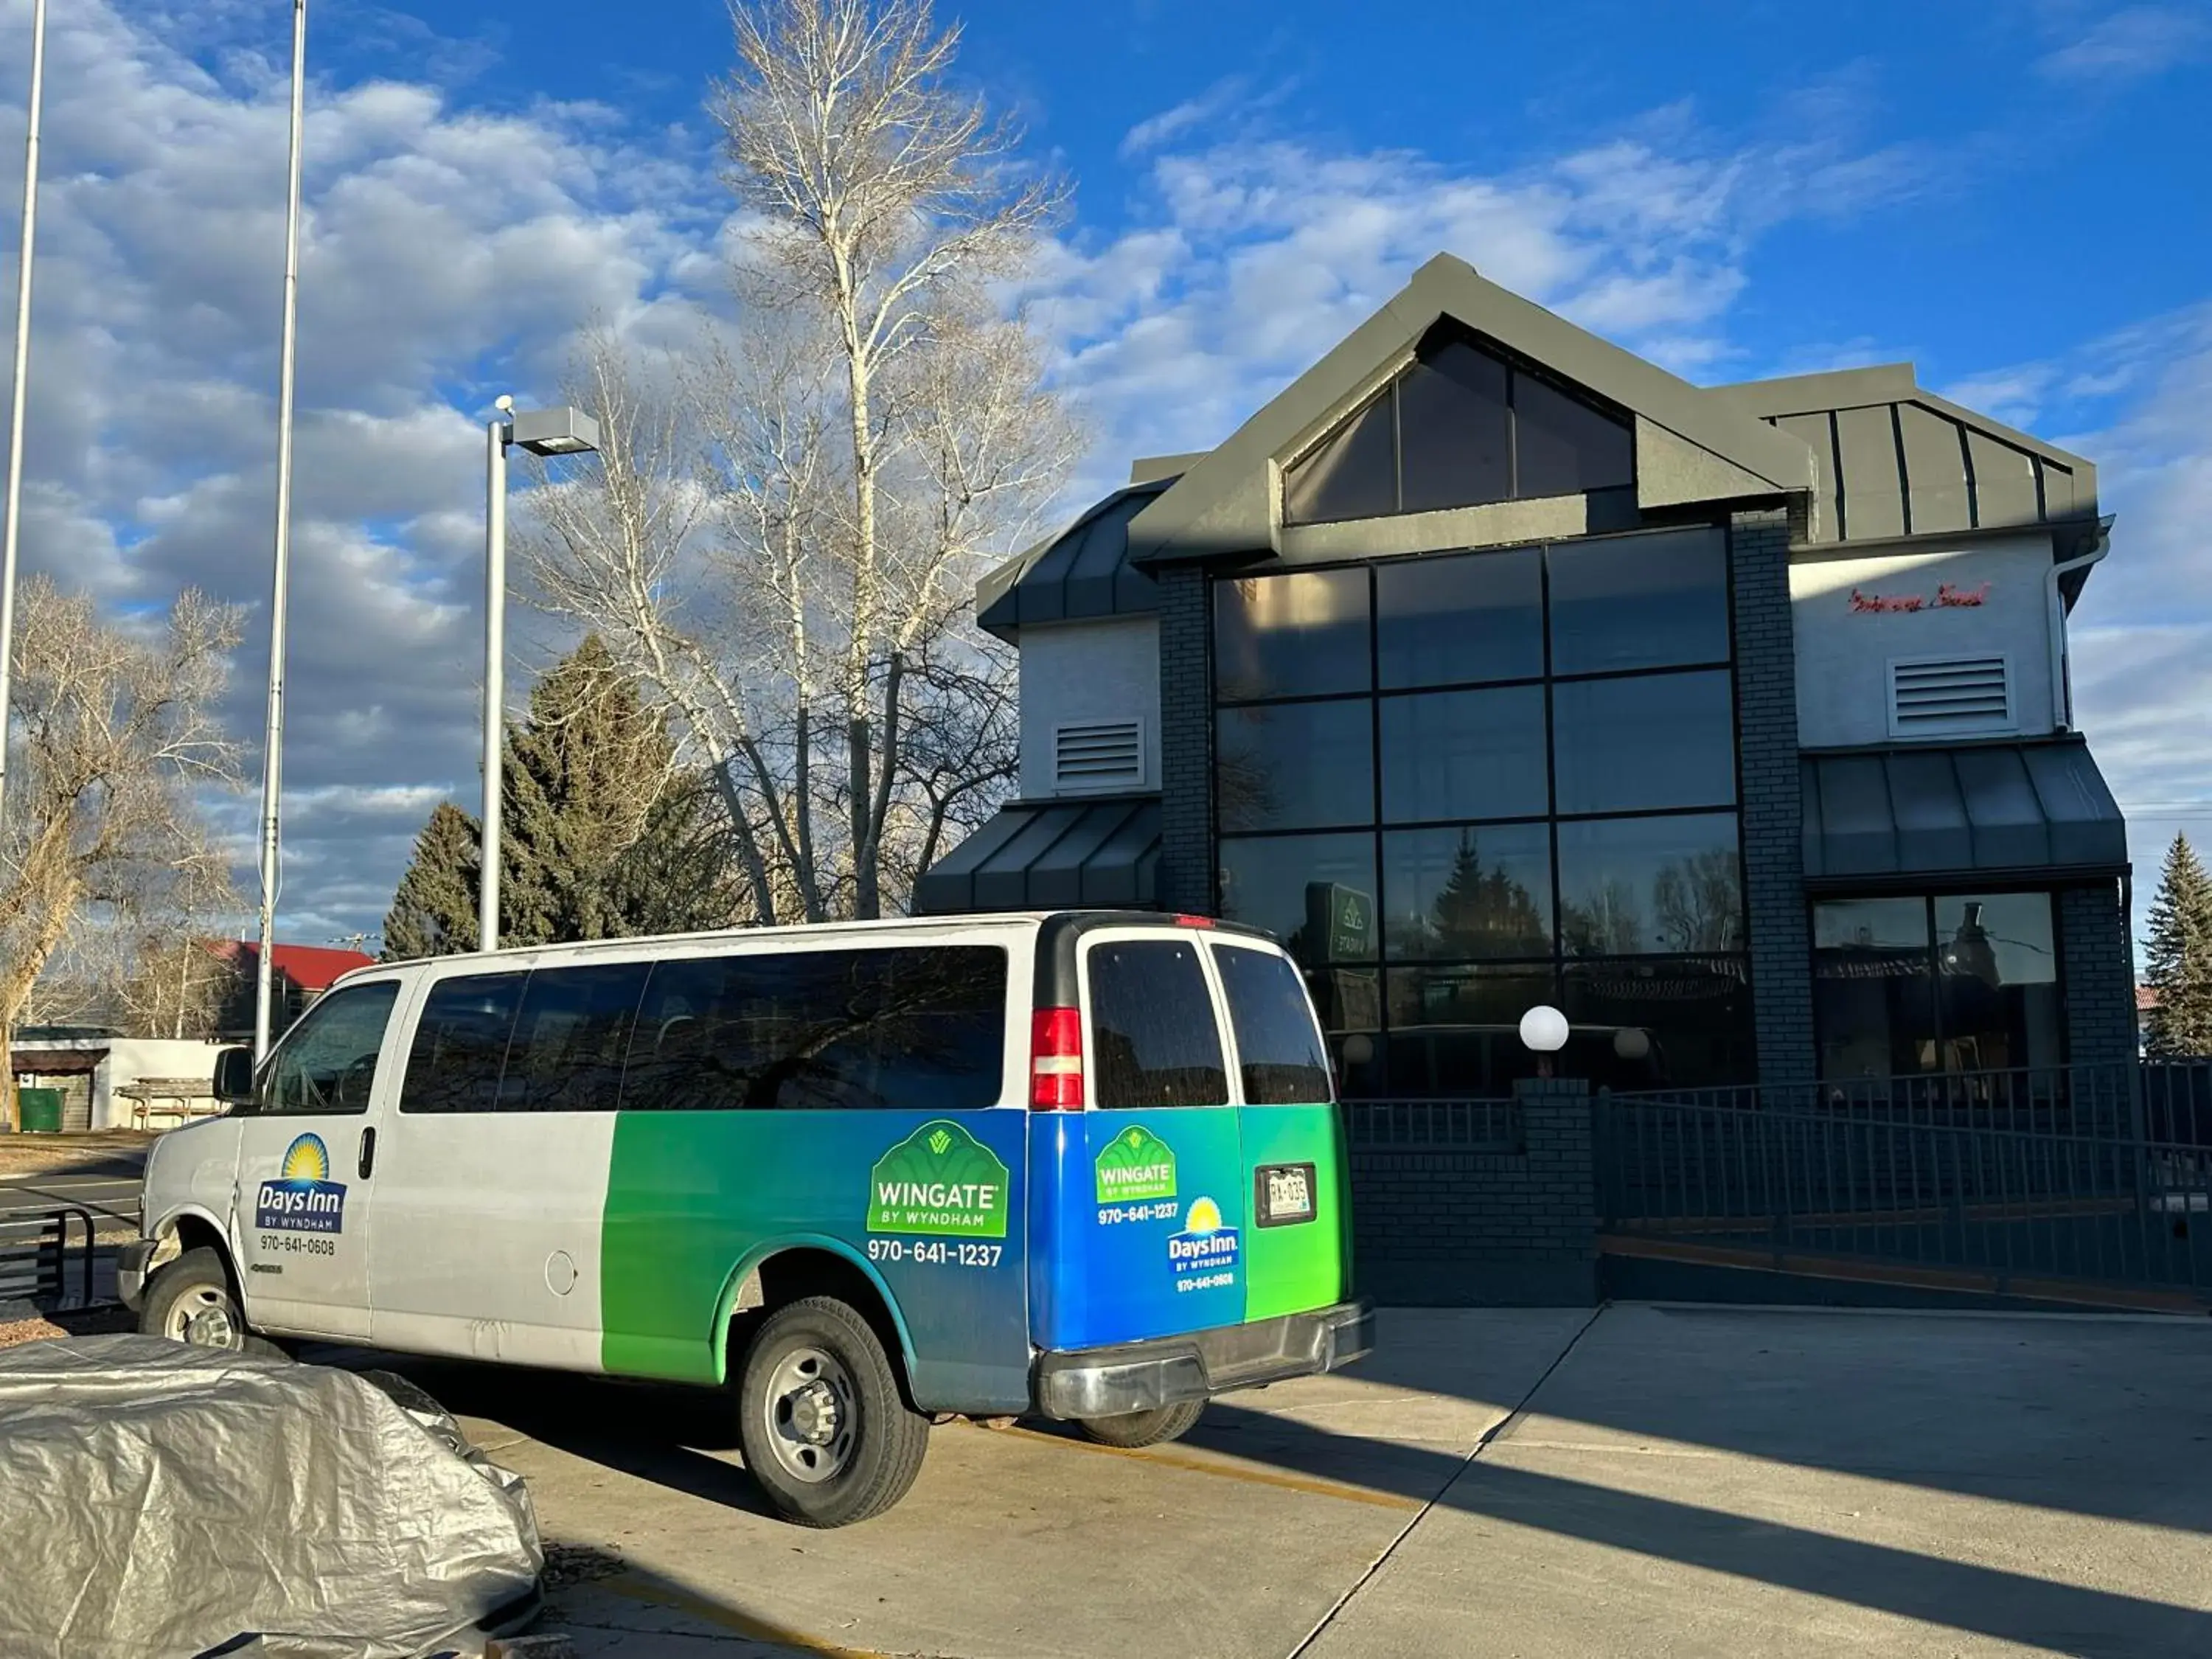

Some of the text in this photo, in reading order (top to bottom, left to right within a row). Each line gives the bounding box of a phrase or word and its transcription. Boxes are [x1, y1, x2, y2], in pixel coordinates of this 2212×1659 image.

[1099, 1164, 1169, 1186] WINGATE
[260, 1186, 339, 1214] Days Inn
[878, 1182, 995, 1209] WINGATE
[265, 1216, 333, 1230] BY WYNDHAM
[881, 1211, 984, 1227] BY WYNDHAM
[1098, 1203, 1178, 1225] 970-641-1237
[260, 1235, 335, 1256] 970-641-0608
[867, 1239, 1002, 1267] 970-641-1237
[1169, 1234, 1236, 1259] Days Inn
[1176, 1255, 1233, 1272] BY WYNDHAM
